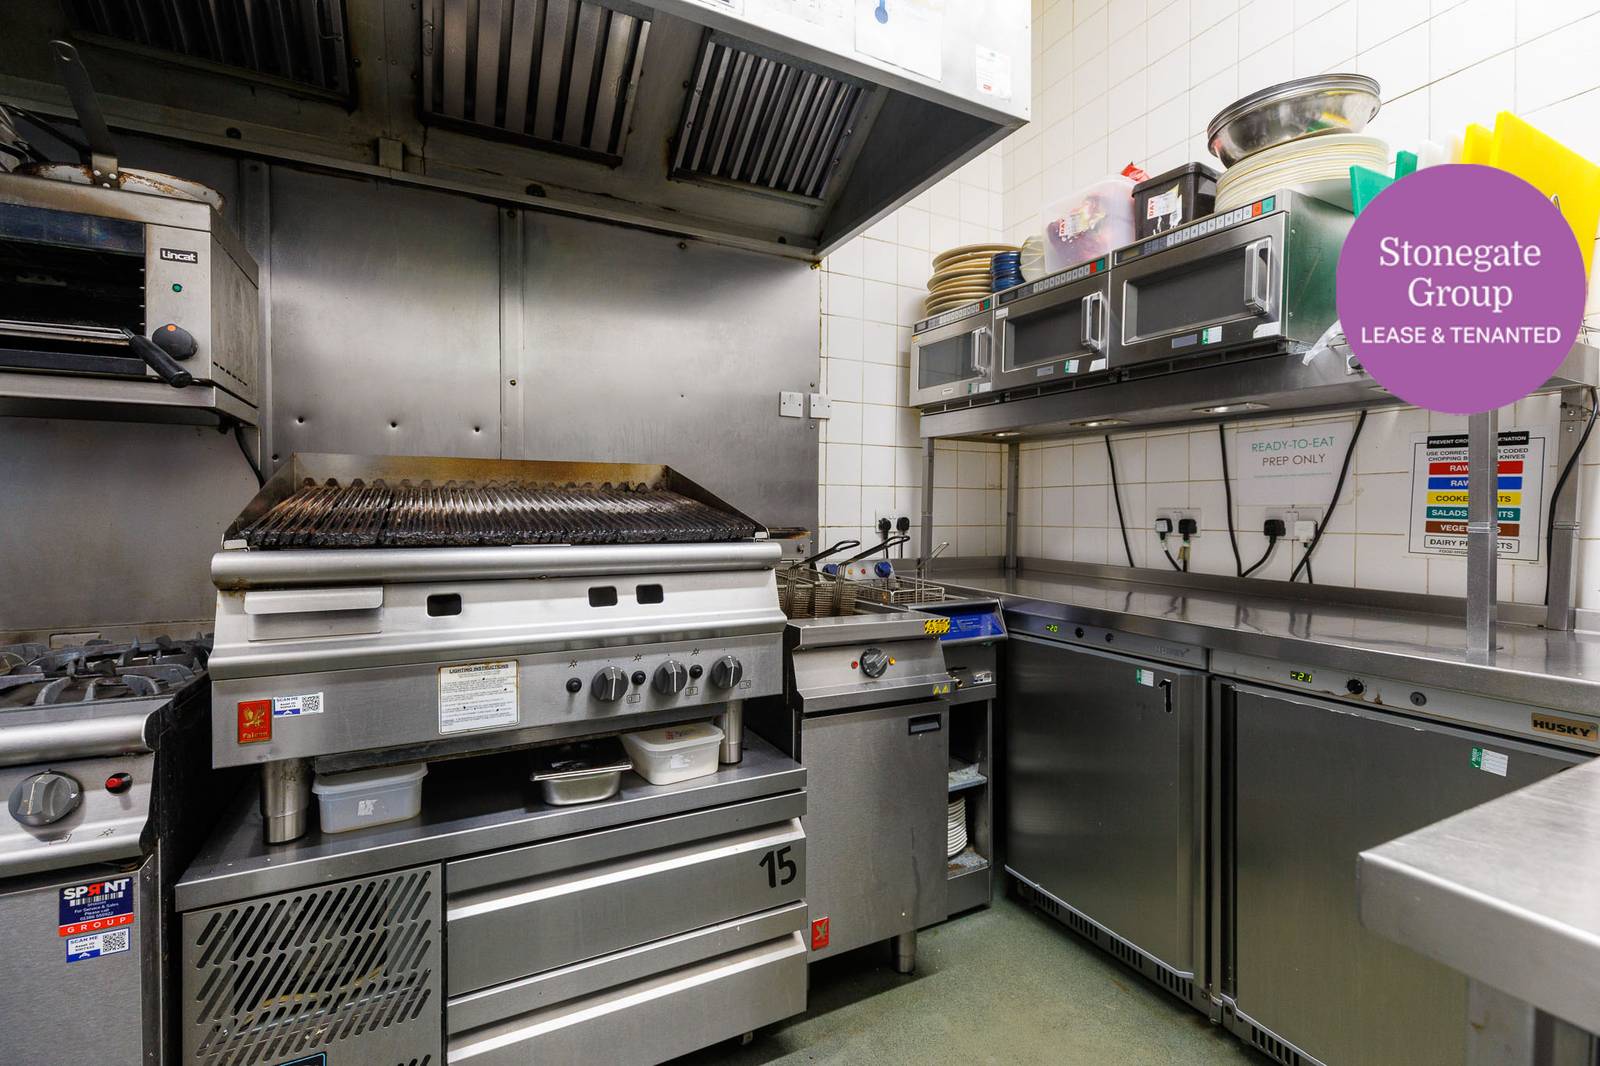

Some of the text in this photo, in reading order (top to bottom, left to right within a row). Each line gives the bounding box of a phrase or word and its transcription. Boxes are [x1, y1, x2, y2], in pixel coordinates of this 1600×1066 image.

[162, 250, 196, 262] Lincat
[1251, 436, 1335, 452] READY-TO-EAT
[1262, 453, 1326, 467] PREP ONLY
[1533, 719, 1591, 737] HUSKY
[758, 845, 797, 889] 15
[67, 916, 126, 934] GROUP
